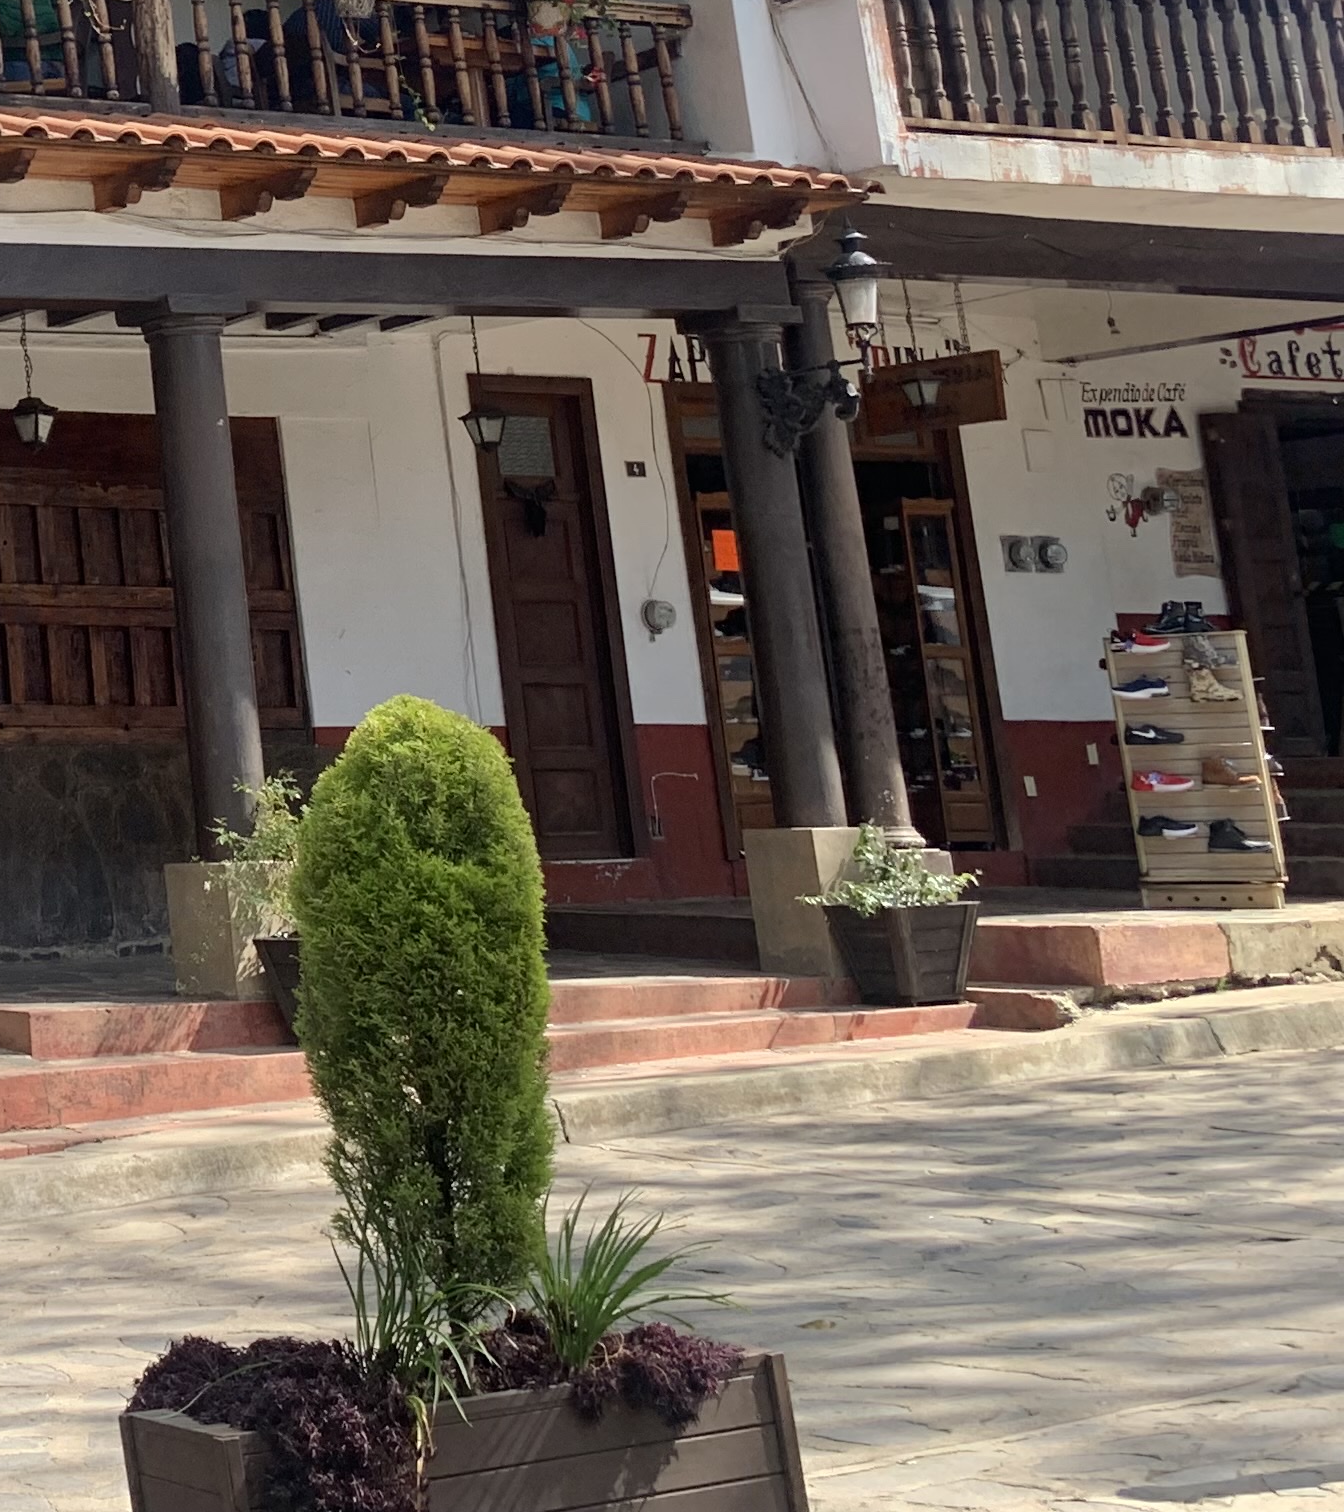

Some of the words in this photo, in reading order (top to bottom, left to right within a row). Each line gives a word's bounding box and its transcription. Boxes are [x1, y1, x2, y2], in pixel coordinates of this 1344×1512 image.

[1080, 381, 1140, 406] Expendio
[1141, 382, 1155, 402] de
[1157, 382, 1186, 402] Café
